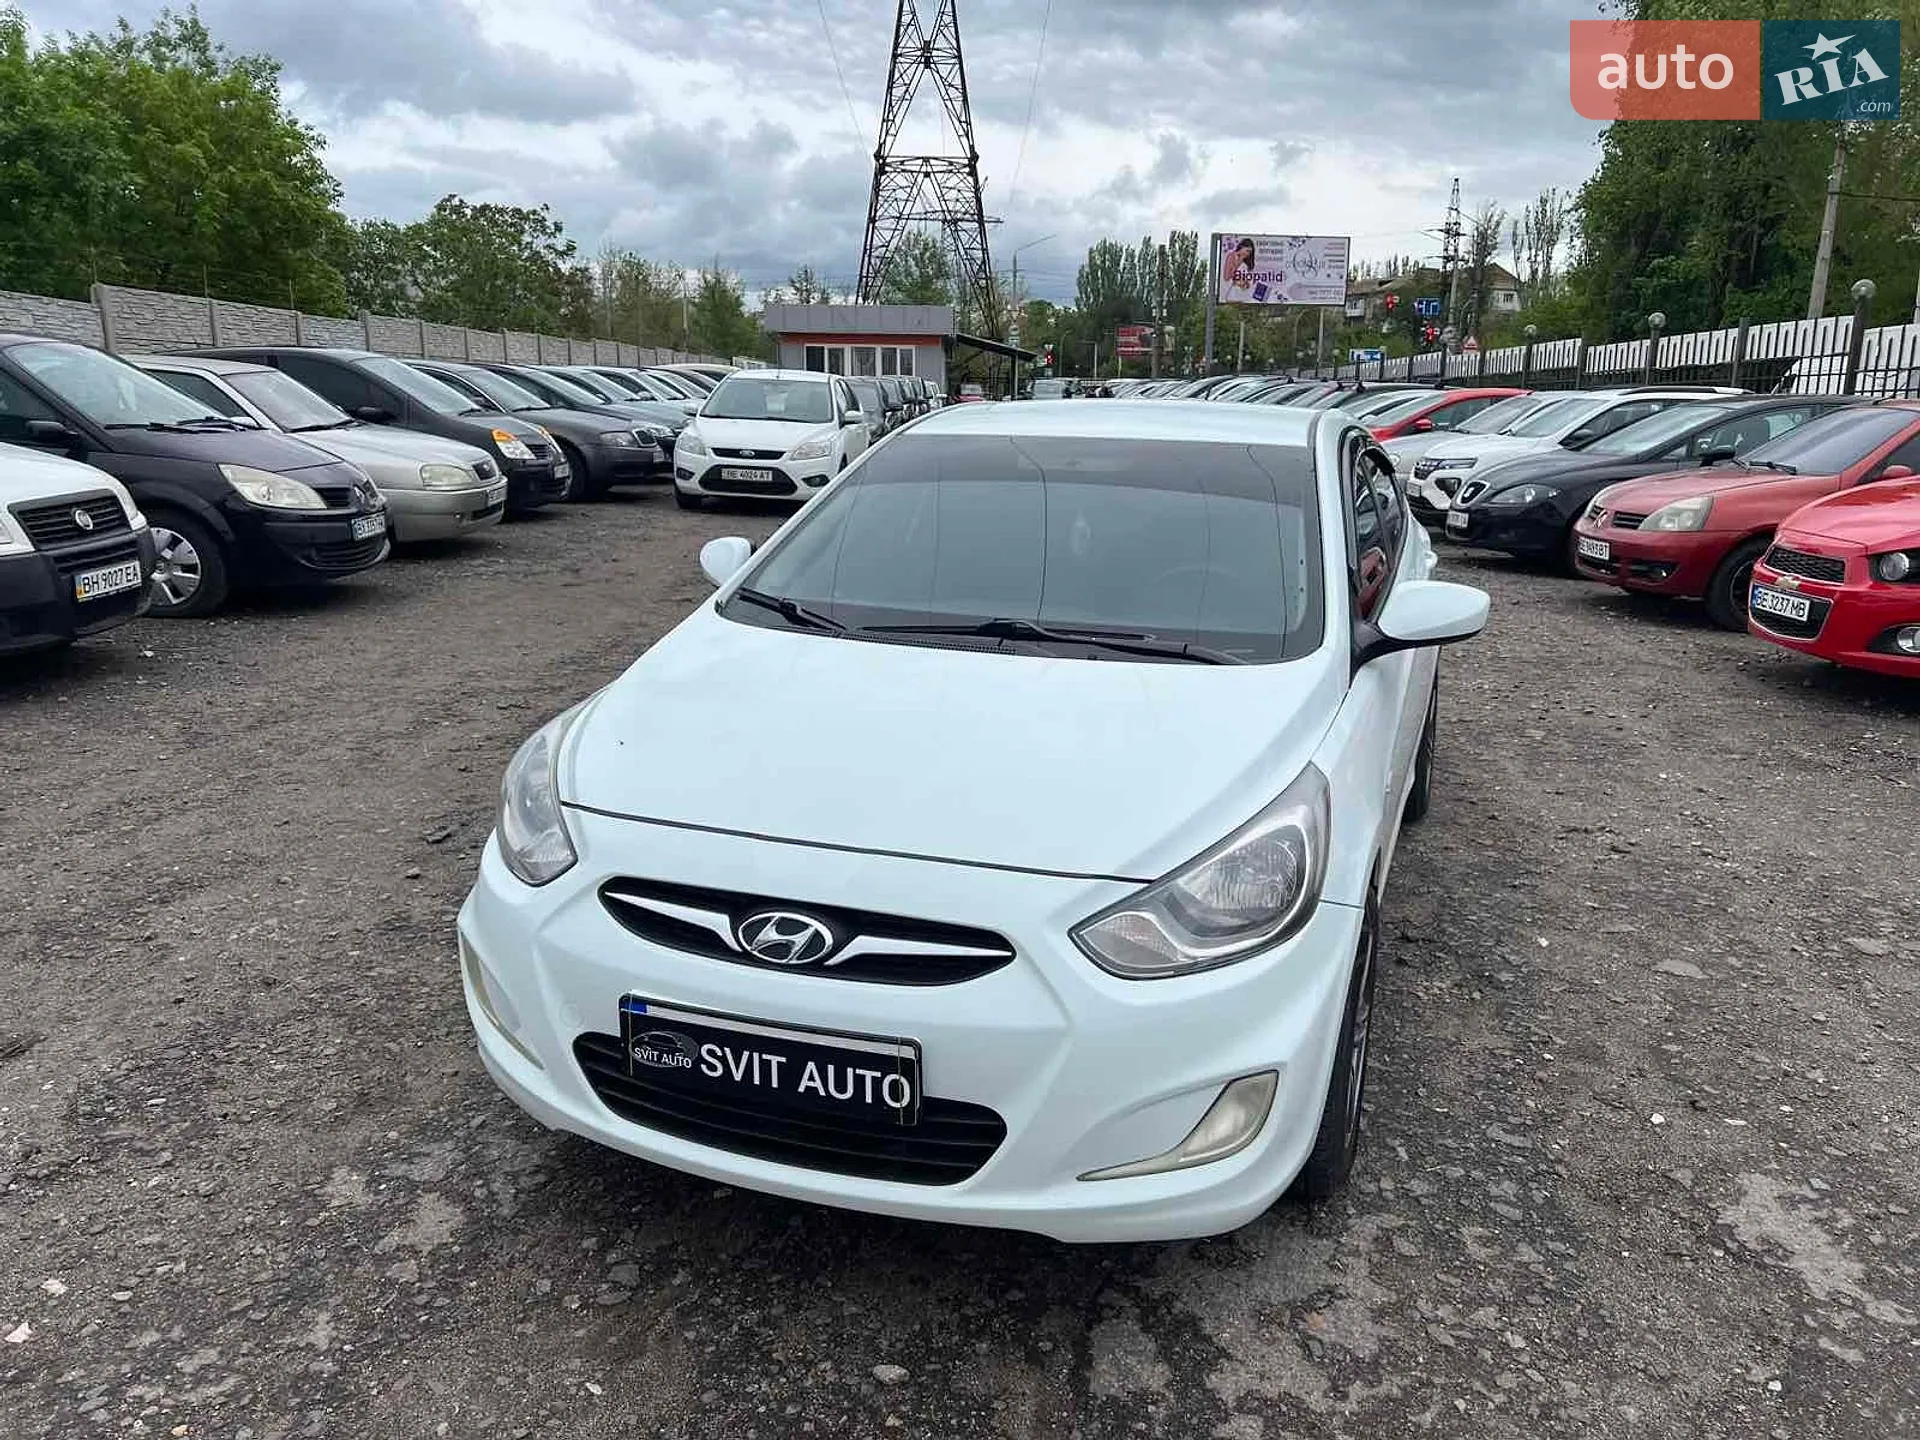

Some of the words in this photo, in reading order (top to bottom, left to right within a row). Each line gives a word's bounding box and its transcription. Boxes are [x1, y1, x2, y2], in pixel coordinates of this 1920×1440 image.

[82, 575, 100, 594] BH
[101, 567, 124, 589] 9027
[125, 564, 139, 583] EA
[1768, 594, 1791, 614] 3237
[1791, 599, 1806, 618] MB
[633, 1047, 660, 1061] SVIT
[661, 1052, 692, 1069] AUTO
[700, 1043, 786, 1088] SVIT
[798, 1061, 911, 1109] AUTO
